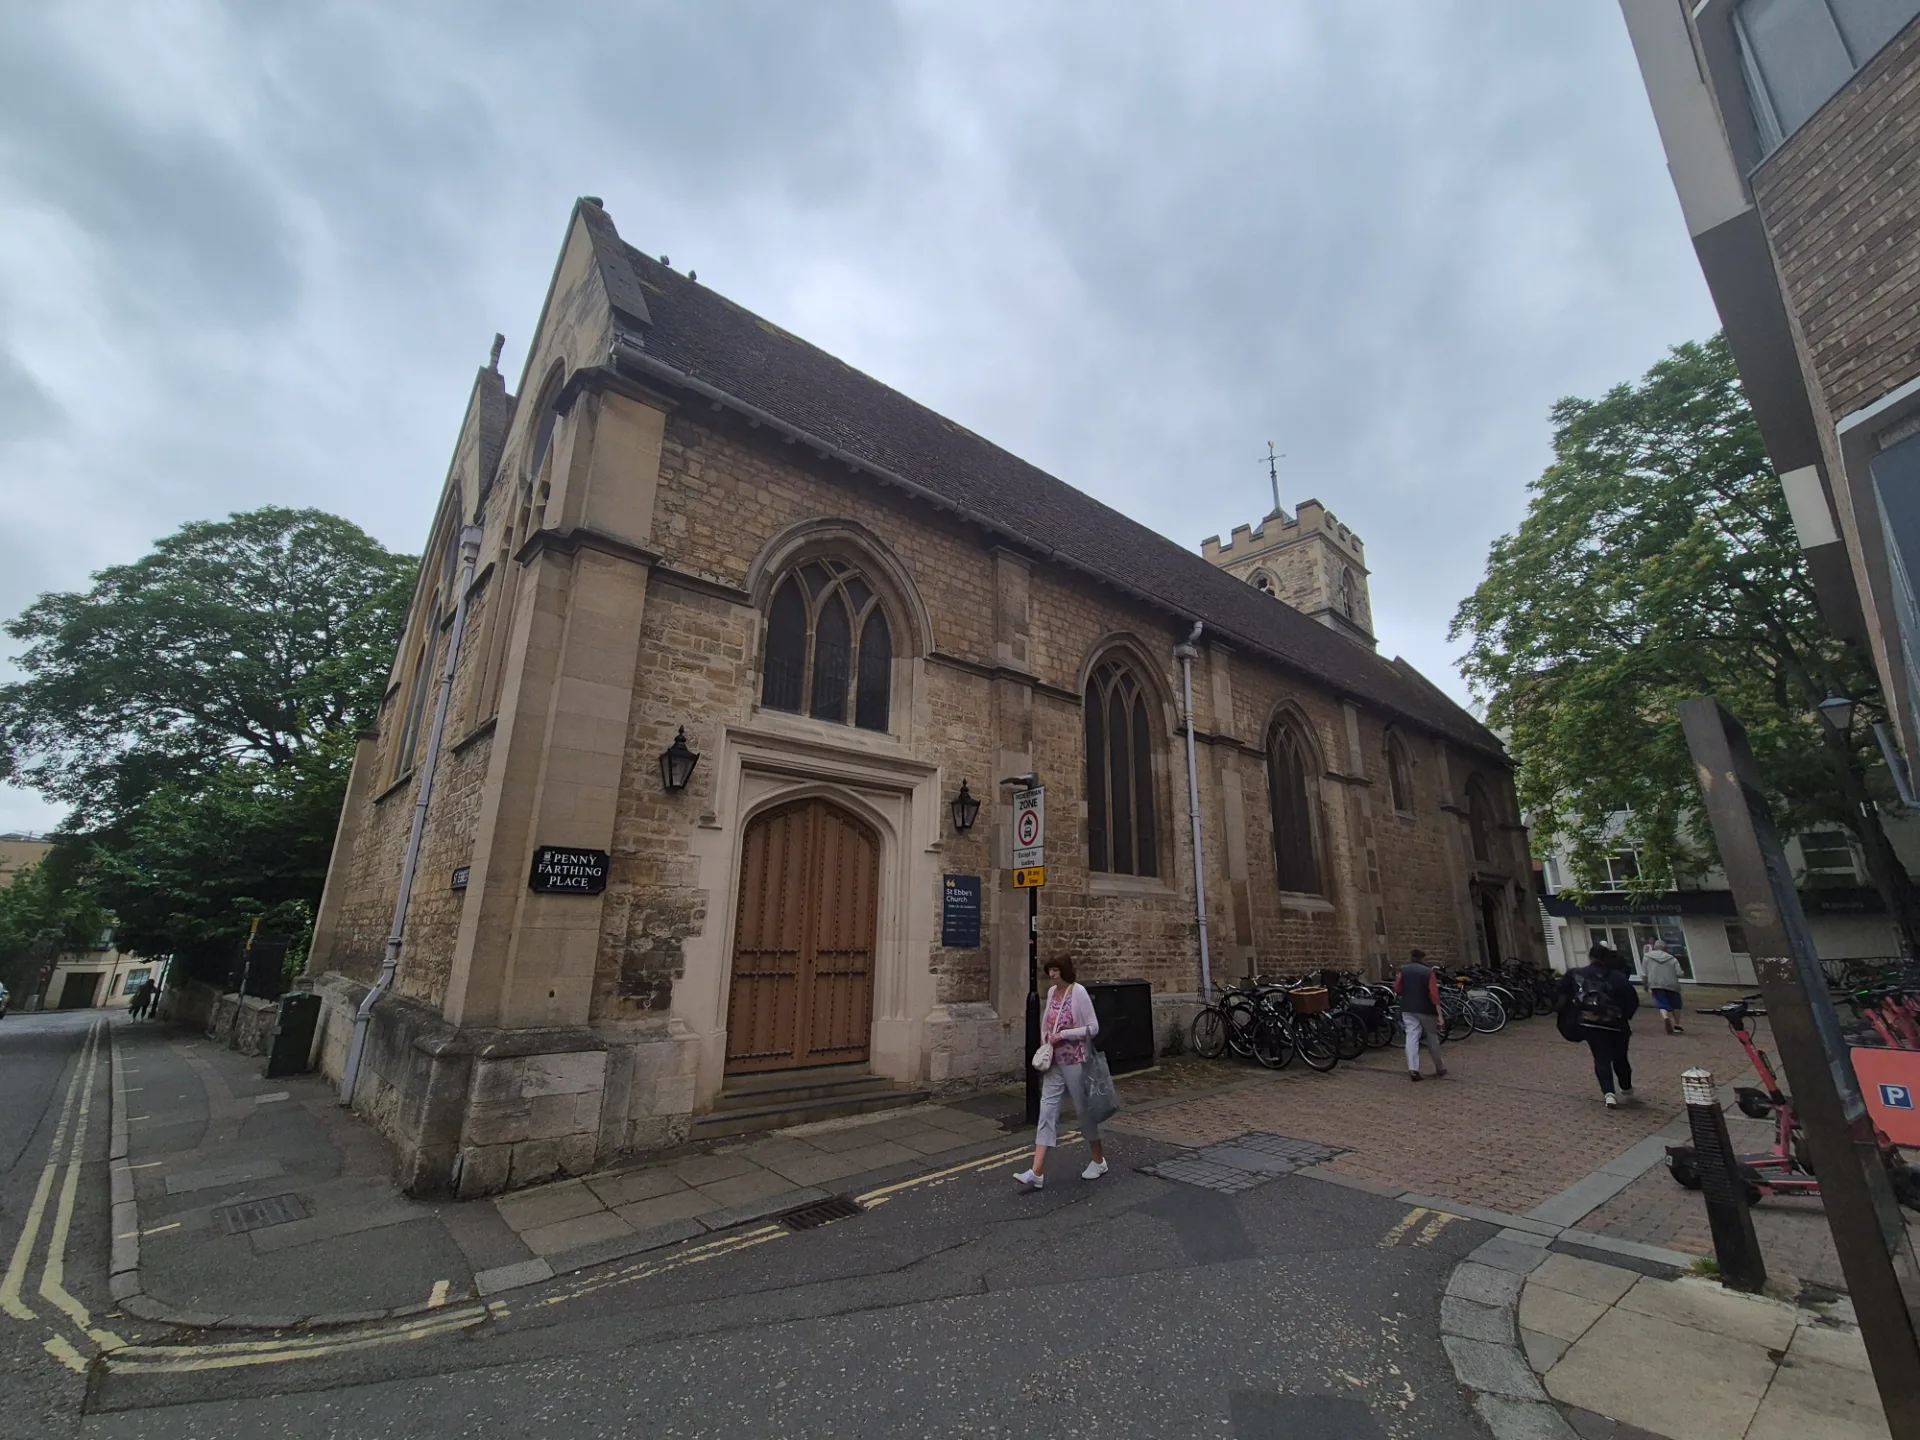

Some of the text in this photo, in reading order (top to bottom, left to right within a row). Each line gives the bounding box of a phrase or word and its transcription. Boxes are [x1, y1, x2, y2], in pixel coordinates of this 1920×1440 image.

[1019, 798, 1038, 810] ZONE
[553, 853, 597, 866] PENNY
[1018, 851, 1031, 859] Except
[537, 863, 602, 877] FARTHING
[549, 875, 589, 887] PLACE
[953, 888, 973, 897] Ebbe's
[946, 895, 968, 903] Church
[1579, 904, 1597, 912] The
[1886, 1086, 1905, 1105] P
